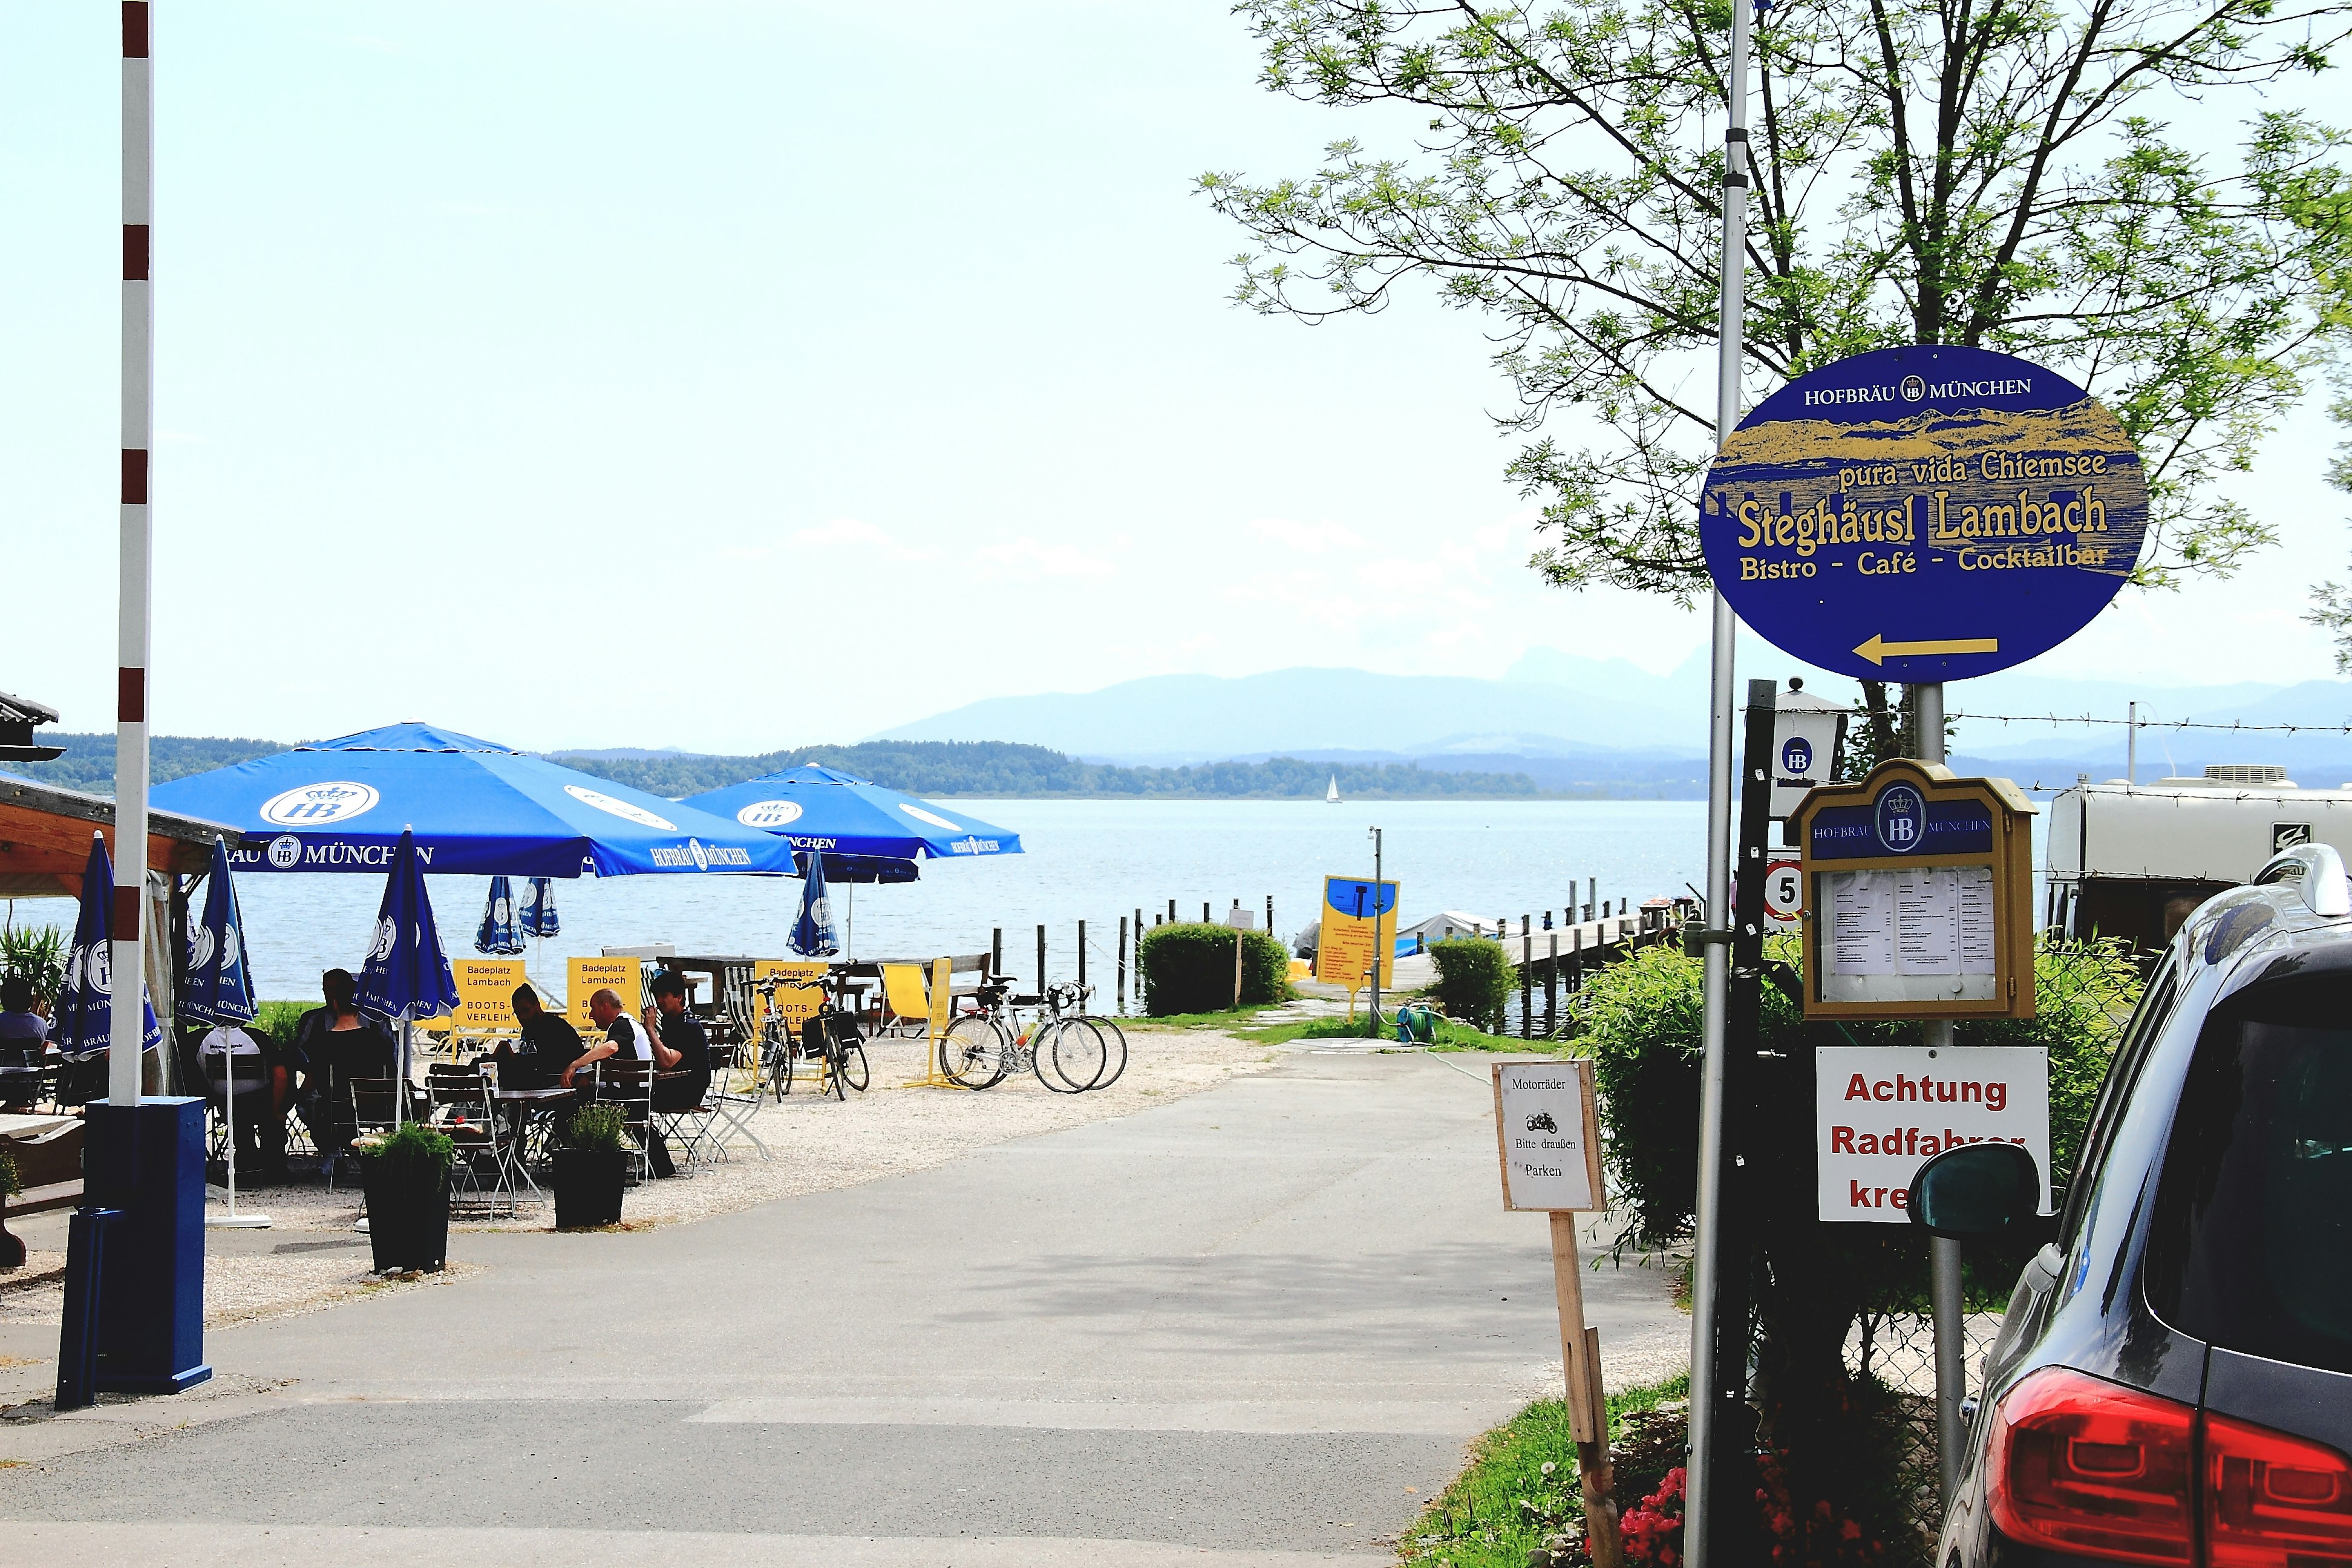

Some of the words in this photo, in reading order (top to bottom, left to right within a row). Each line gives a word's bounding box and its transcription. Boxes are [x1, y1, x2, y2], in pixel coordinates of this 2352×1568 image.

[1805, 385, 1895, 405] HOFBRÄU
[1930, 379, 2031, 399] MÜNCHEN
[1839, 465, 1897, 493] pura
[1912, 454, 1967, 483] vida
[1982, 452, 2106, 480] Chiemsee
[1738, 495, 1915, 557] Steghäusl
[1935, 486, 2108, 539] Lambach
[1740, 557, 1817, 580] Bistro
[1858, 552, 1916, 575] Café
[1958, 544, 2108, 570] Cocktailbar
[1788, 754, 1806, 769] HB
[1889, 818, 1913, 841] HB
[276, 851, 292, 862] HB
[304, 841, 434, 864] MÜNCHN
[781, 835, 837, 849] NCHEN
[650, 844, 694, 866] HOFBRÄU
[704, 844, 752, 865] MÜNCHEN
[1780, 877, 1795, 904] 5
[468, 966, 511, 975] Badeplatz
[582, 964, 626, 973] Badeplatz
[770, 969, 814, 978] Badeplatz
[468, 978, 511, 986] Lambach
[1512, 1078, 1566, 1090] Motorräder
[1844, 1073, 2007, 1111] Achtung
[1515, 1138, 1536, 1149] Bitte
[1541, 1138, 1576, 1149] draußen
[1831, 1126, 2027, 1157] Radfah
[1525, 1164, 1561, 1177] Parken
[1850, 1179, 1910, 1209] kre
